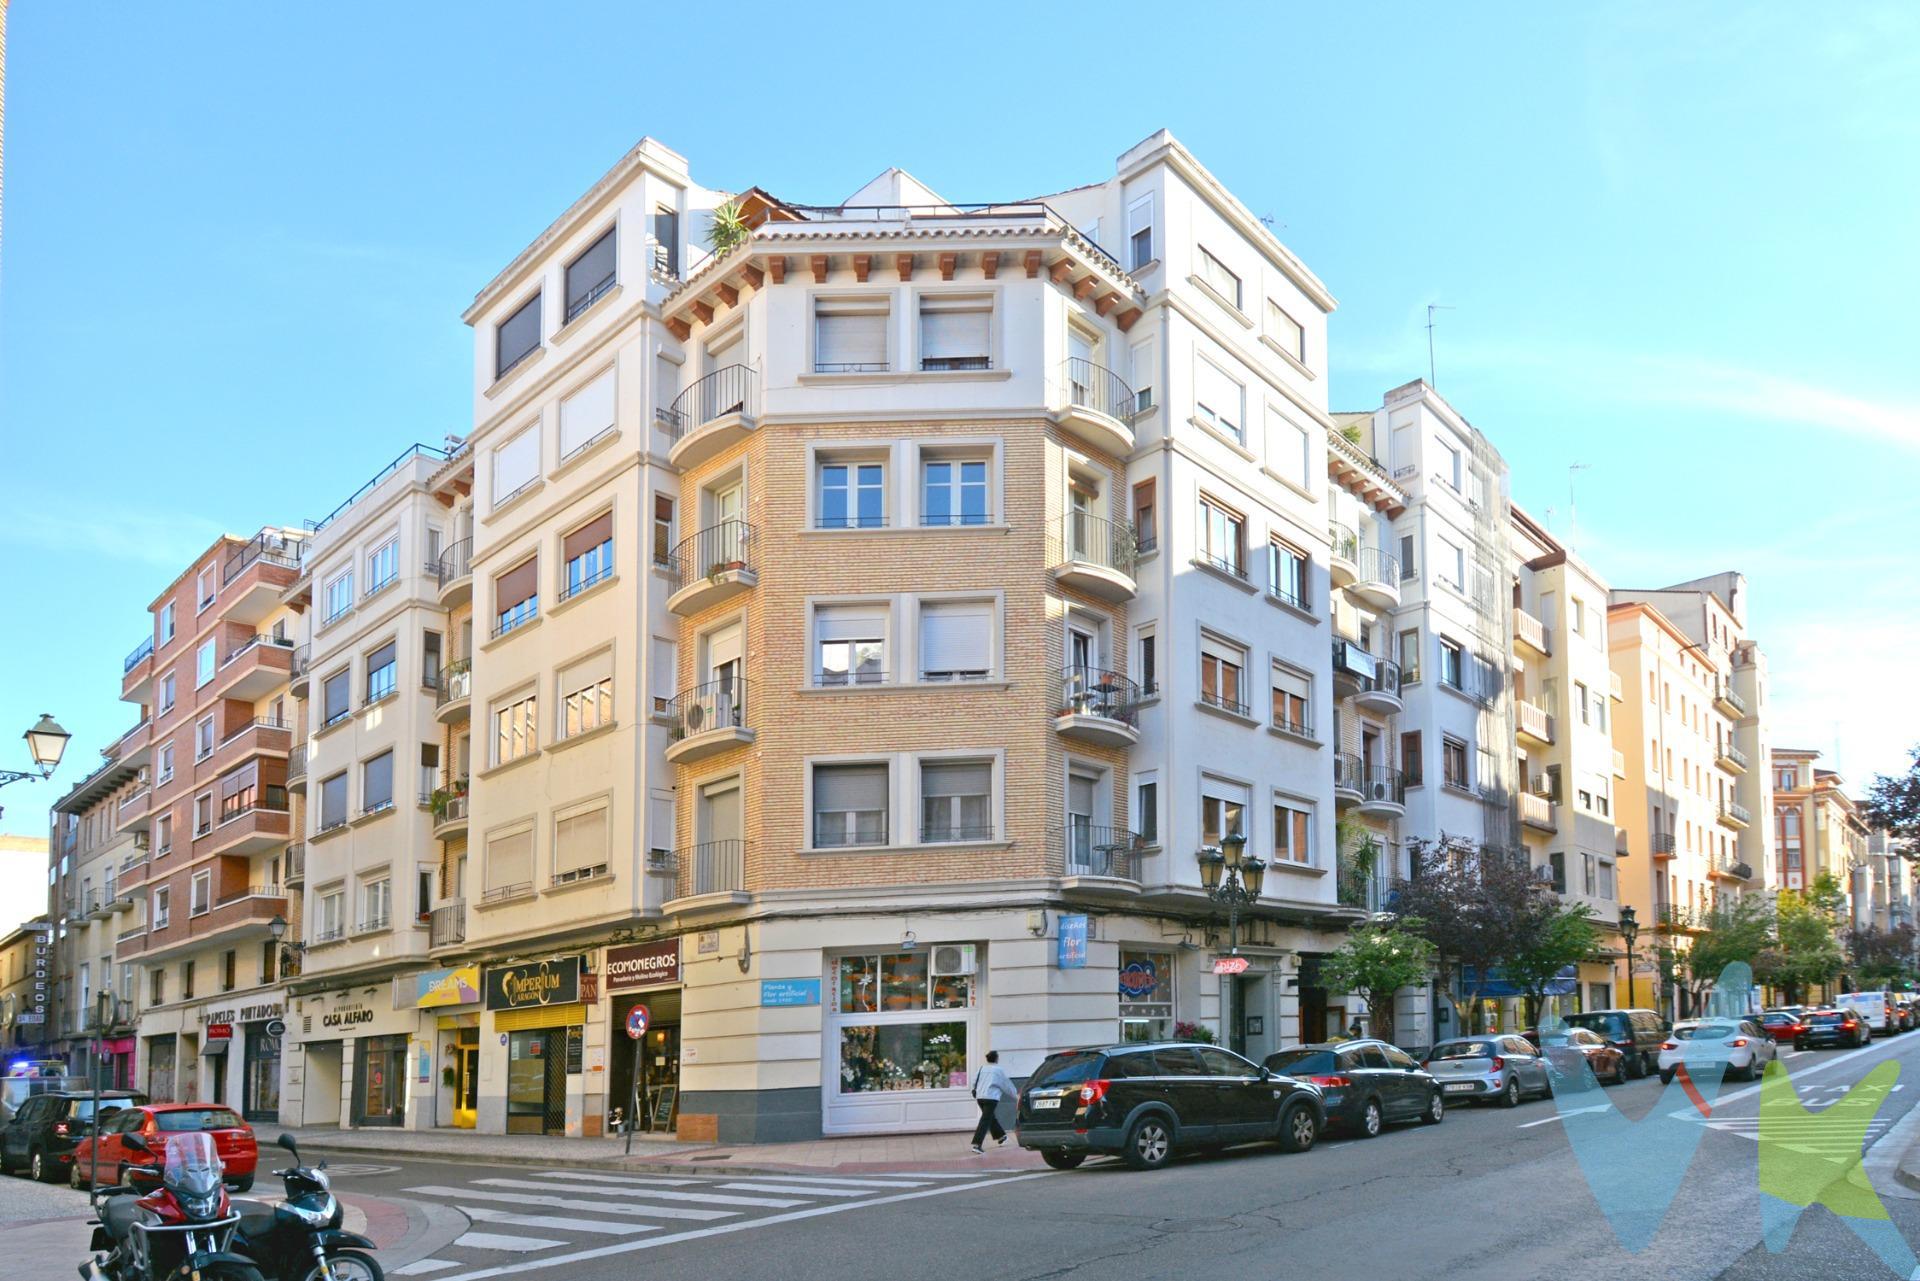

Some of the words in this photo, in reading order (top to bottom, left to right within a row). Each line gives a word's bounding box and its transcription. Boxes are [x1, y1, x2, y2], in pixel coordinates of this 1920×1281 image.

[1064, 936, 1081, 948] flor
[607, 953, 676, 975] ECOMONEGROS
[35, 935, 46, 1014] BURDEOS
[580, 984, 597, 999] PAN
[207, 1010, 235, 1024] PAPELES
[323, 1013, 342, 1027] CASA
[344, 1010, 373, 1024] ALFARO
[1800, 1084, 1905, 1092] TAXI
[1761, 1098, 1877, 1107] BUS
